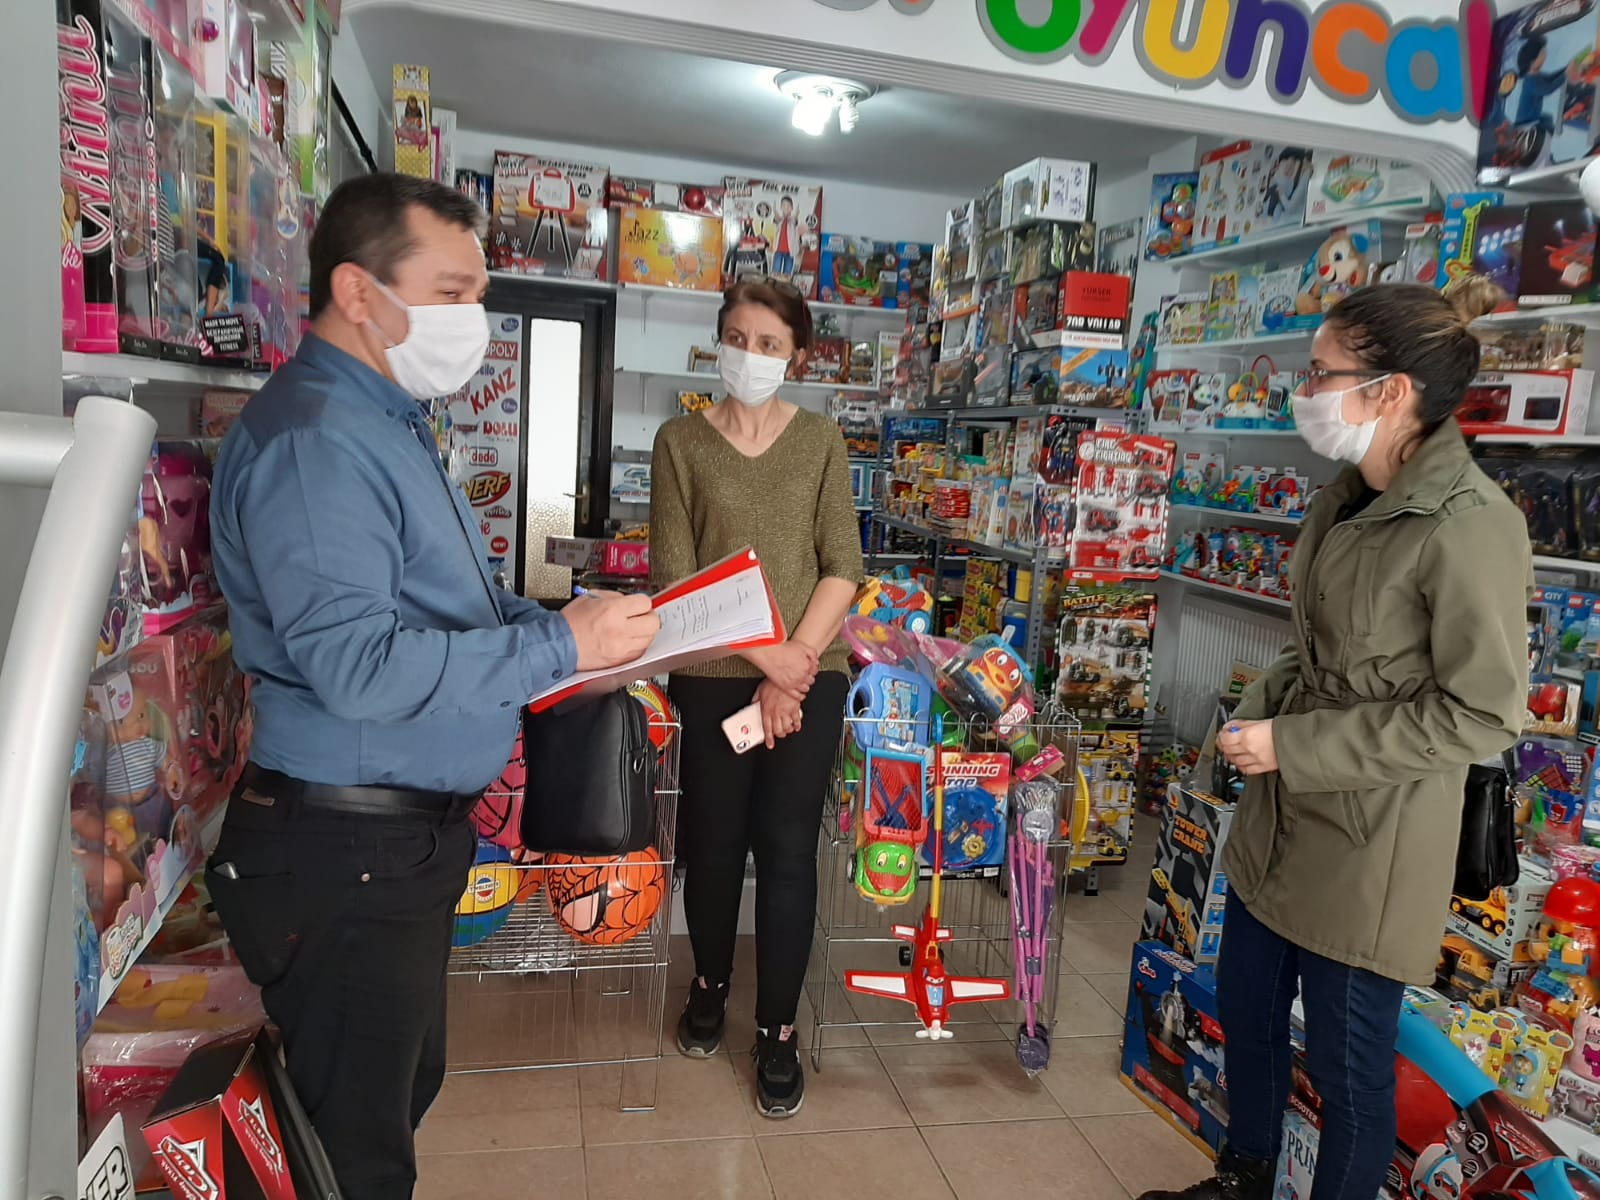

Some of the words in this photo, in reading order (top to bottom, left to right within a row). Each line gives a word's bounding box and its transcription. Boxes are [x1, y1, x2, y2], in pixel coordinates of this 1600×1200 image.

[627, 219, 660, 242] Jazz
[469, 366, 516, 416] KANZ
[472, 451, 496, 464] dede
[1544, 591, 1563, 601] CITY
[946, 777, 977, 789] TOP
[1174, 814, 1209, 842] TOWER
[1172, 828, 1206, 856] CRANE
[166, 1142, 209, 1192] Cars
